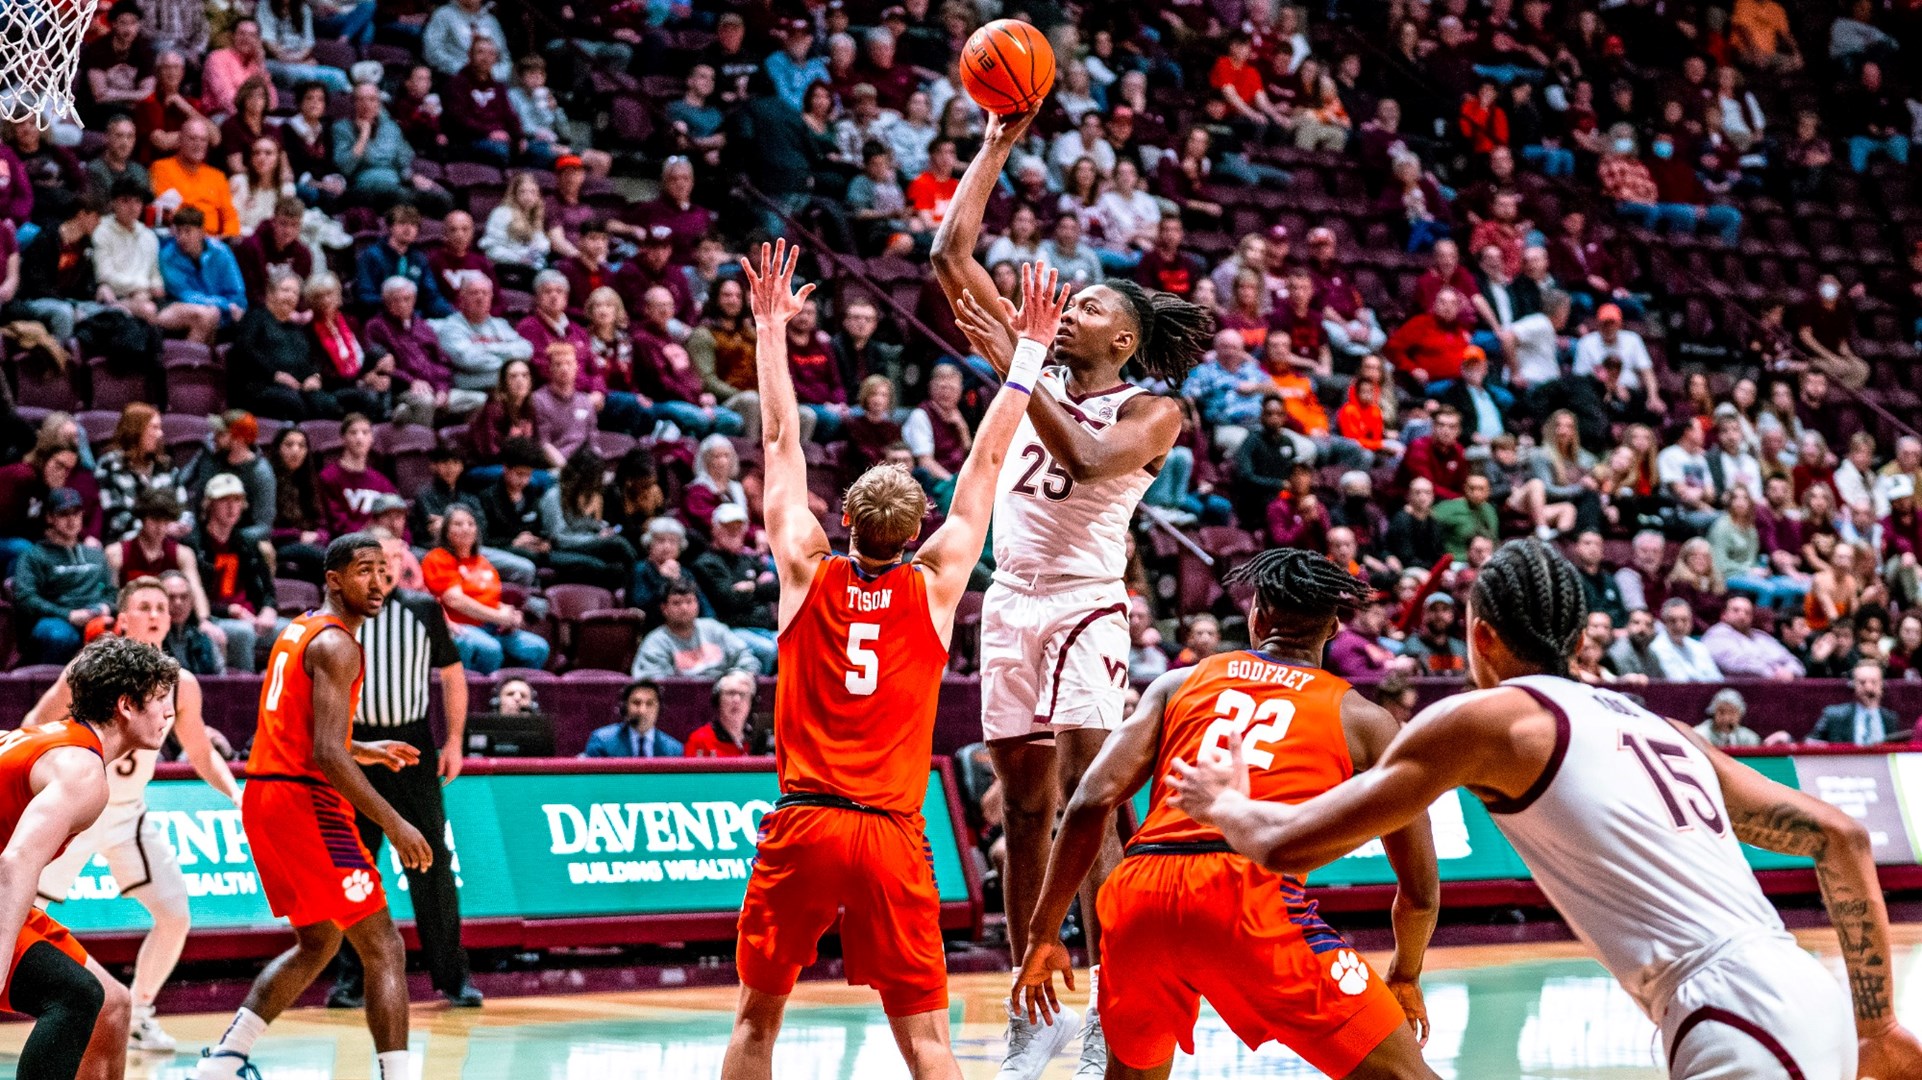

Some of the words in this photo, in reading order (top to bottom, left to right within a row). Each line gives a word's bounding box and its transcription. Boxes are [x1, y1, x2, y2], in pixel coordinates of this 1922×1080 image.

[1009, 441, 1076, 503] 25
[265, 651, 289, 711] 0
[845, 622, 880, 696] 5
[1227, 660, 1315, 691] GODFREY
[1196, 688, 1296, 770] 22
[1617, 729, 1726, 839] 15
[567, 859, 664, 885] BUILDING
[663, 857, 747, 881] WEALTH
